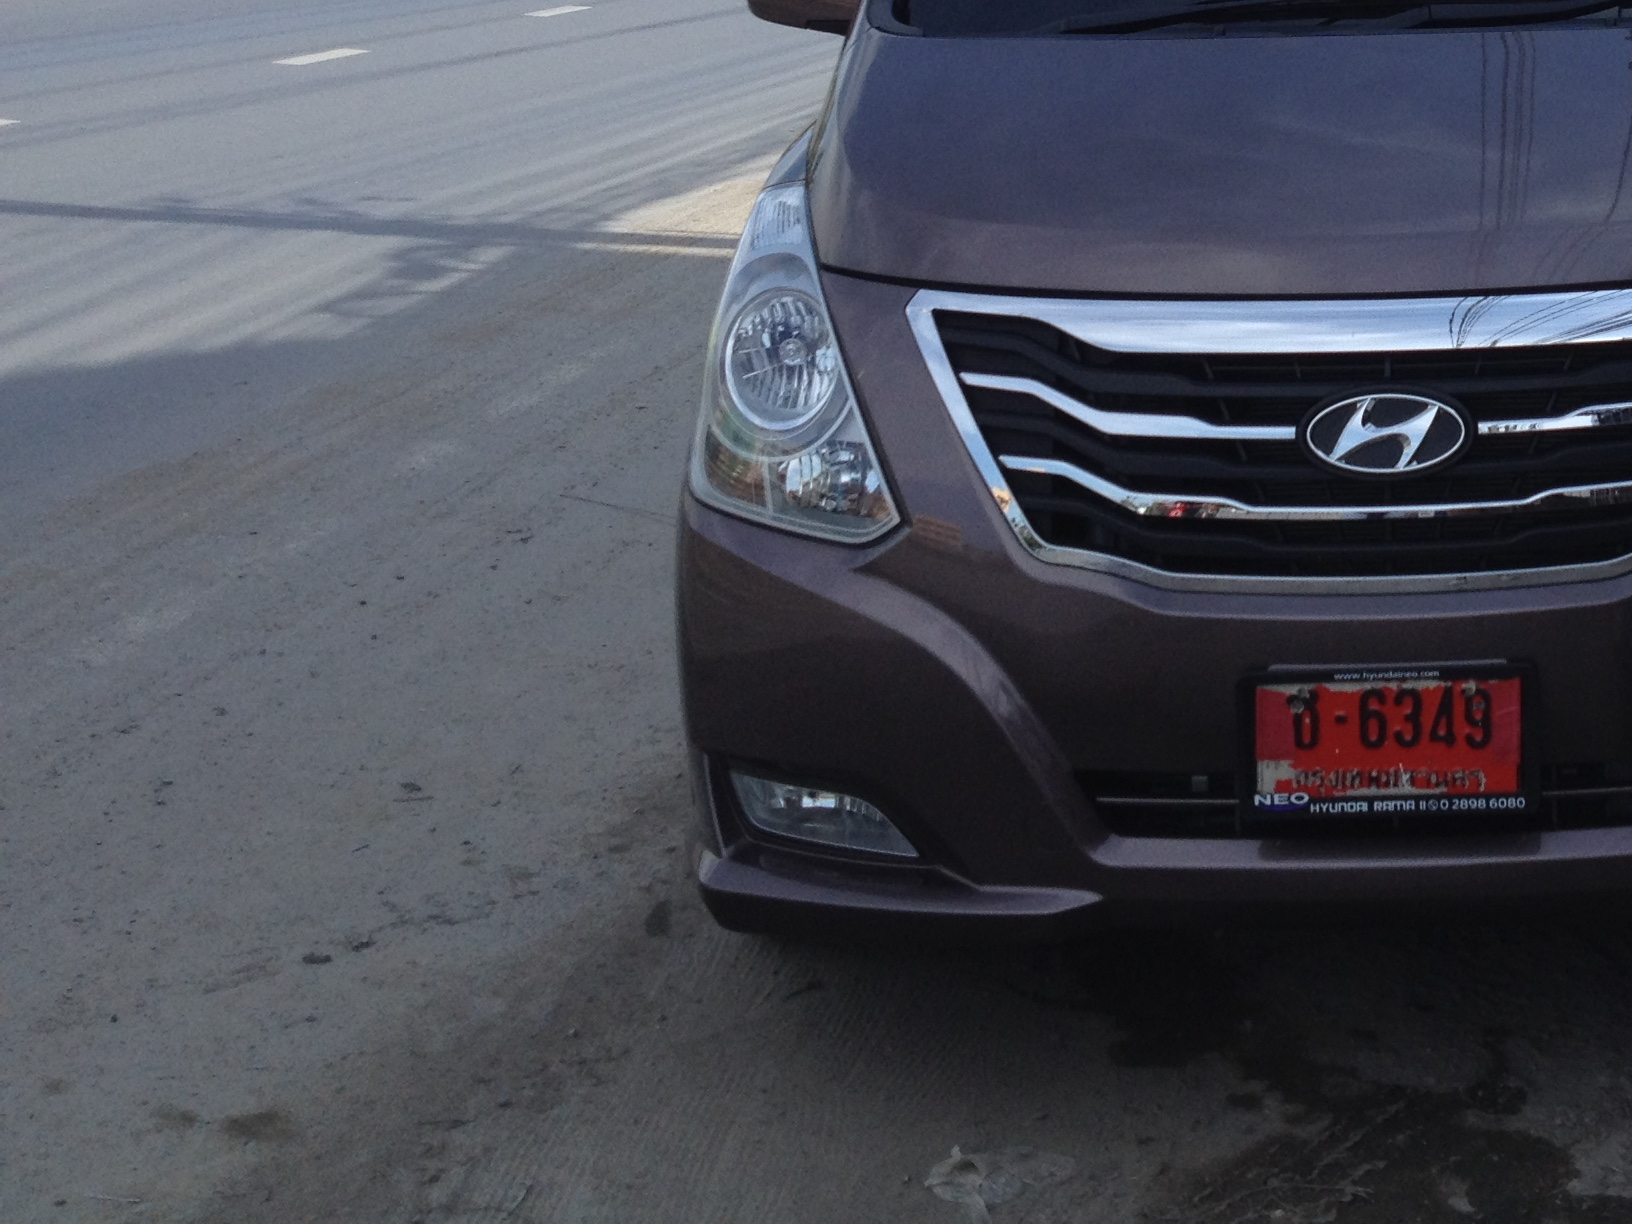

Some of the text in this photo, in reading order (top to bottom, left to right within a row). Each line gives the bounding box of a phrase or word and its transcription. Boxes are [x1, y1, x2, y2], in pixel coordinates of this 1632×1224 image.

[1334, 669, 1440, 681] www.hyundaineo.com
[1254, 792, 1309, 806] NEO
[1310, 801, 1368, 813] HYUNDAI
[1374, 799, 1415, 812] RAMA
[1452, 797, 1486, 810] 2898
[1489, 796, 1526, 809] 6080
